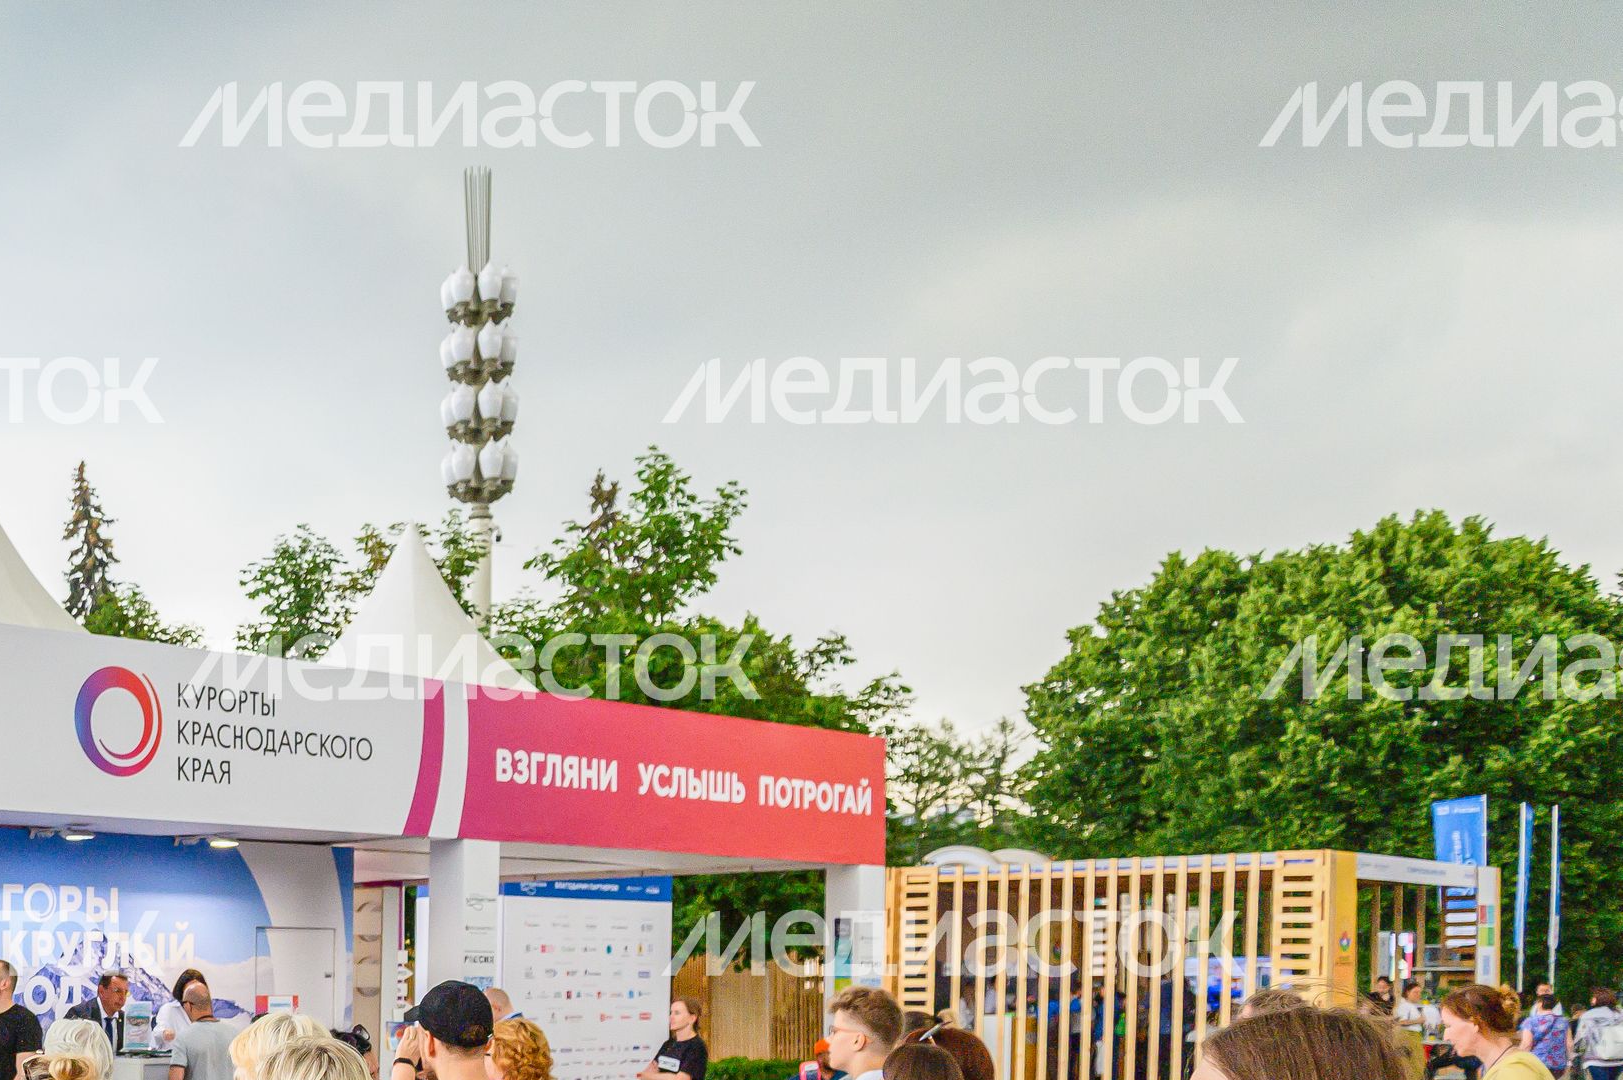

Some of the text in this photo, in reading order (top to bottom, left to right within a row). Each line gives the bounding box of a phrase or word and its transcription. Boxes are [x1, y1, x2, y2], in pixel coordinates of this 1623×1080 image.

[177, 682, 277, 717] КУРОРТЫ
[177, 719, 373, 762] КРАСНОДАРСКОГО
[177, 755, 231, 786] КРАЯ
[495, 747, 873, 816] ВЗГЛЯНИ УСЛЫШЬ ПОТРОГАЙ
[2, 883, 119, 923] ГОРЫ
[2, 920, 195, 968] КРУГЛЫЙ
